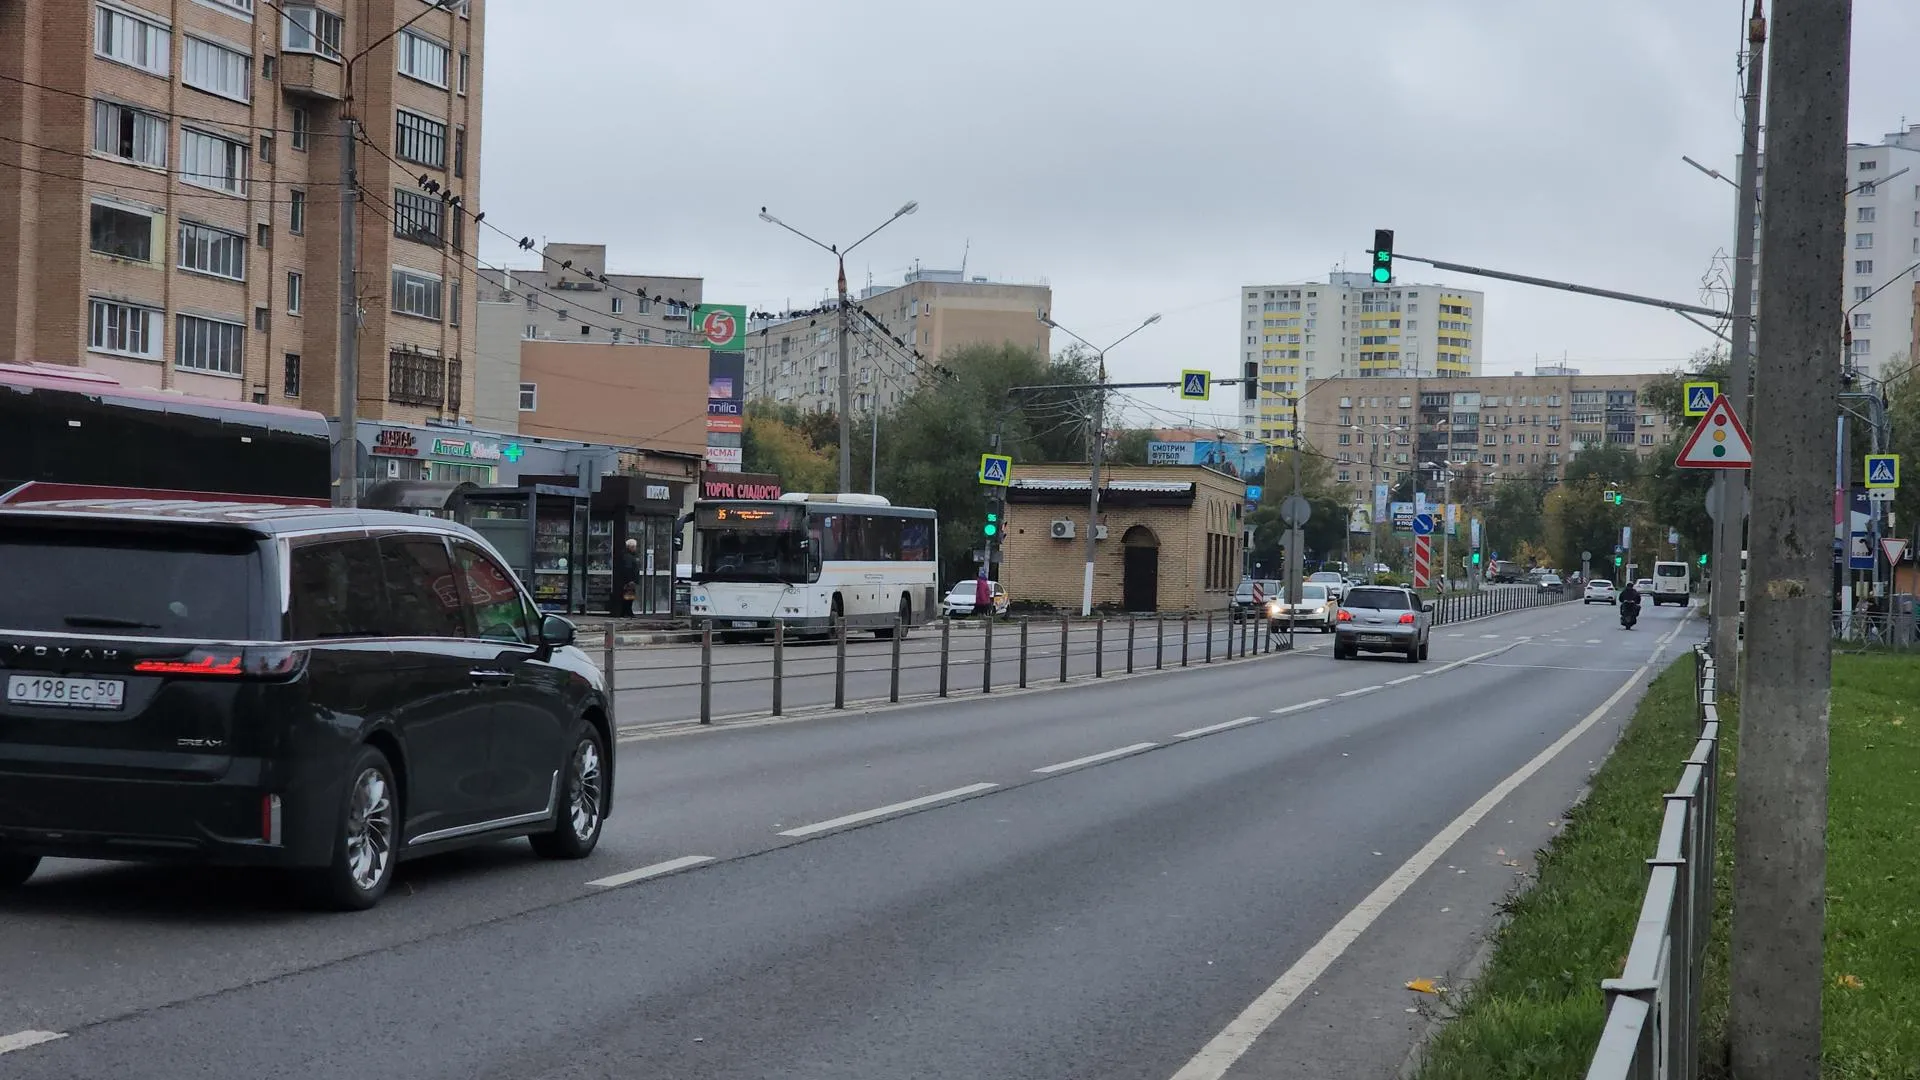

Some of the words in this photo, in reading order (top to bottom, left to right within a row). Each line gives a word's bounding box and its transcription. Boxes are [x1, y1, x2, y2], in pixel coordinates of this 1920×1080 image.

[1152, 444, 1185, 453] СМОТРИМ
[1152, 452, 1180, 460] ФУТБОЛ
[705, 481, 734, 498] ТОРТЫ
[737, 484, 781, 500] СЛАДОСТИ
[177, 738, 225, 747] DREAM
